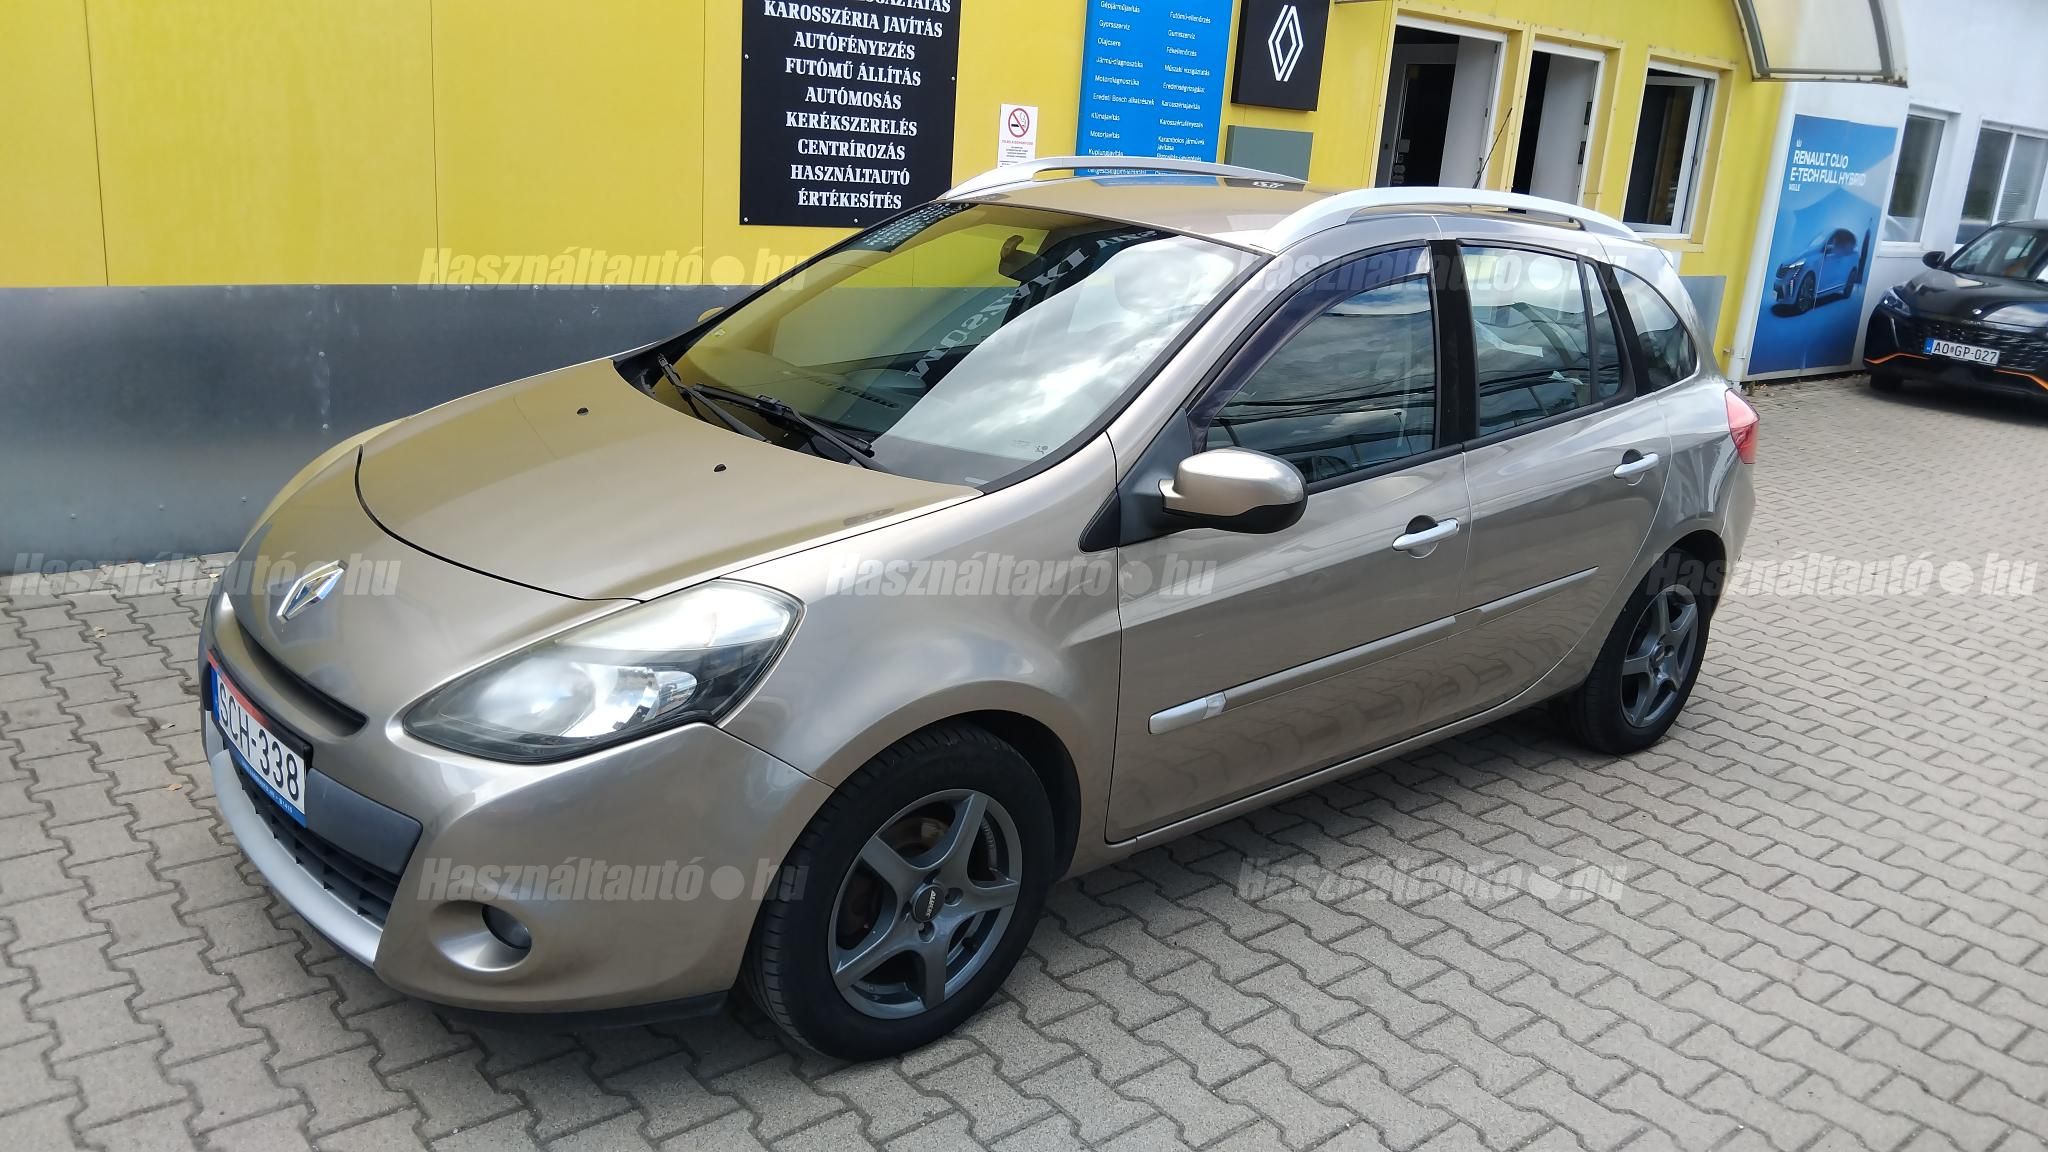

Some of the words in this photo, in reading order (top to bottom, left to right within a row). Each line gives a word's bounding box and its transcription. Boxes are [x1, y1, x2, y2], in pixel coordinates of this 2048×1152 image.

[764, 0, 880, 30] KAROSSZÉRIA
[883, 15, 943, 38] JAVÍTÁS
[794, 31, 915, 60] AUTÓFÉNYEZÉS
[785, 57, 853, 80] FUTÓMŰ
[857, 62, 921, 86] ÁLLÍTÁS
[805, 86, 902, 110] AUTÓMOSÁS
[786, 111, 918, 137] KERÉKSZERELÉS
[797, 138, 906, 160] CENTRÍROZÁS
[1793, 150, 1831, 166] RENAULT
[1830, 154, 1849, 169] CLIO
[790, 164, 910, 186] HASZNÁLTAUTÓ
[1790, 167, 1820, 183] E-TECH
[1819, 169, 1838, 184] FULL
[1838, 171, 1867, 187] HYBRID
[798, 188, 902, 210] ÉRTÉKESÍTÉS
[219, 681, 300, 801] SCH-338
